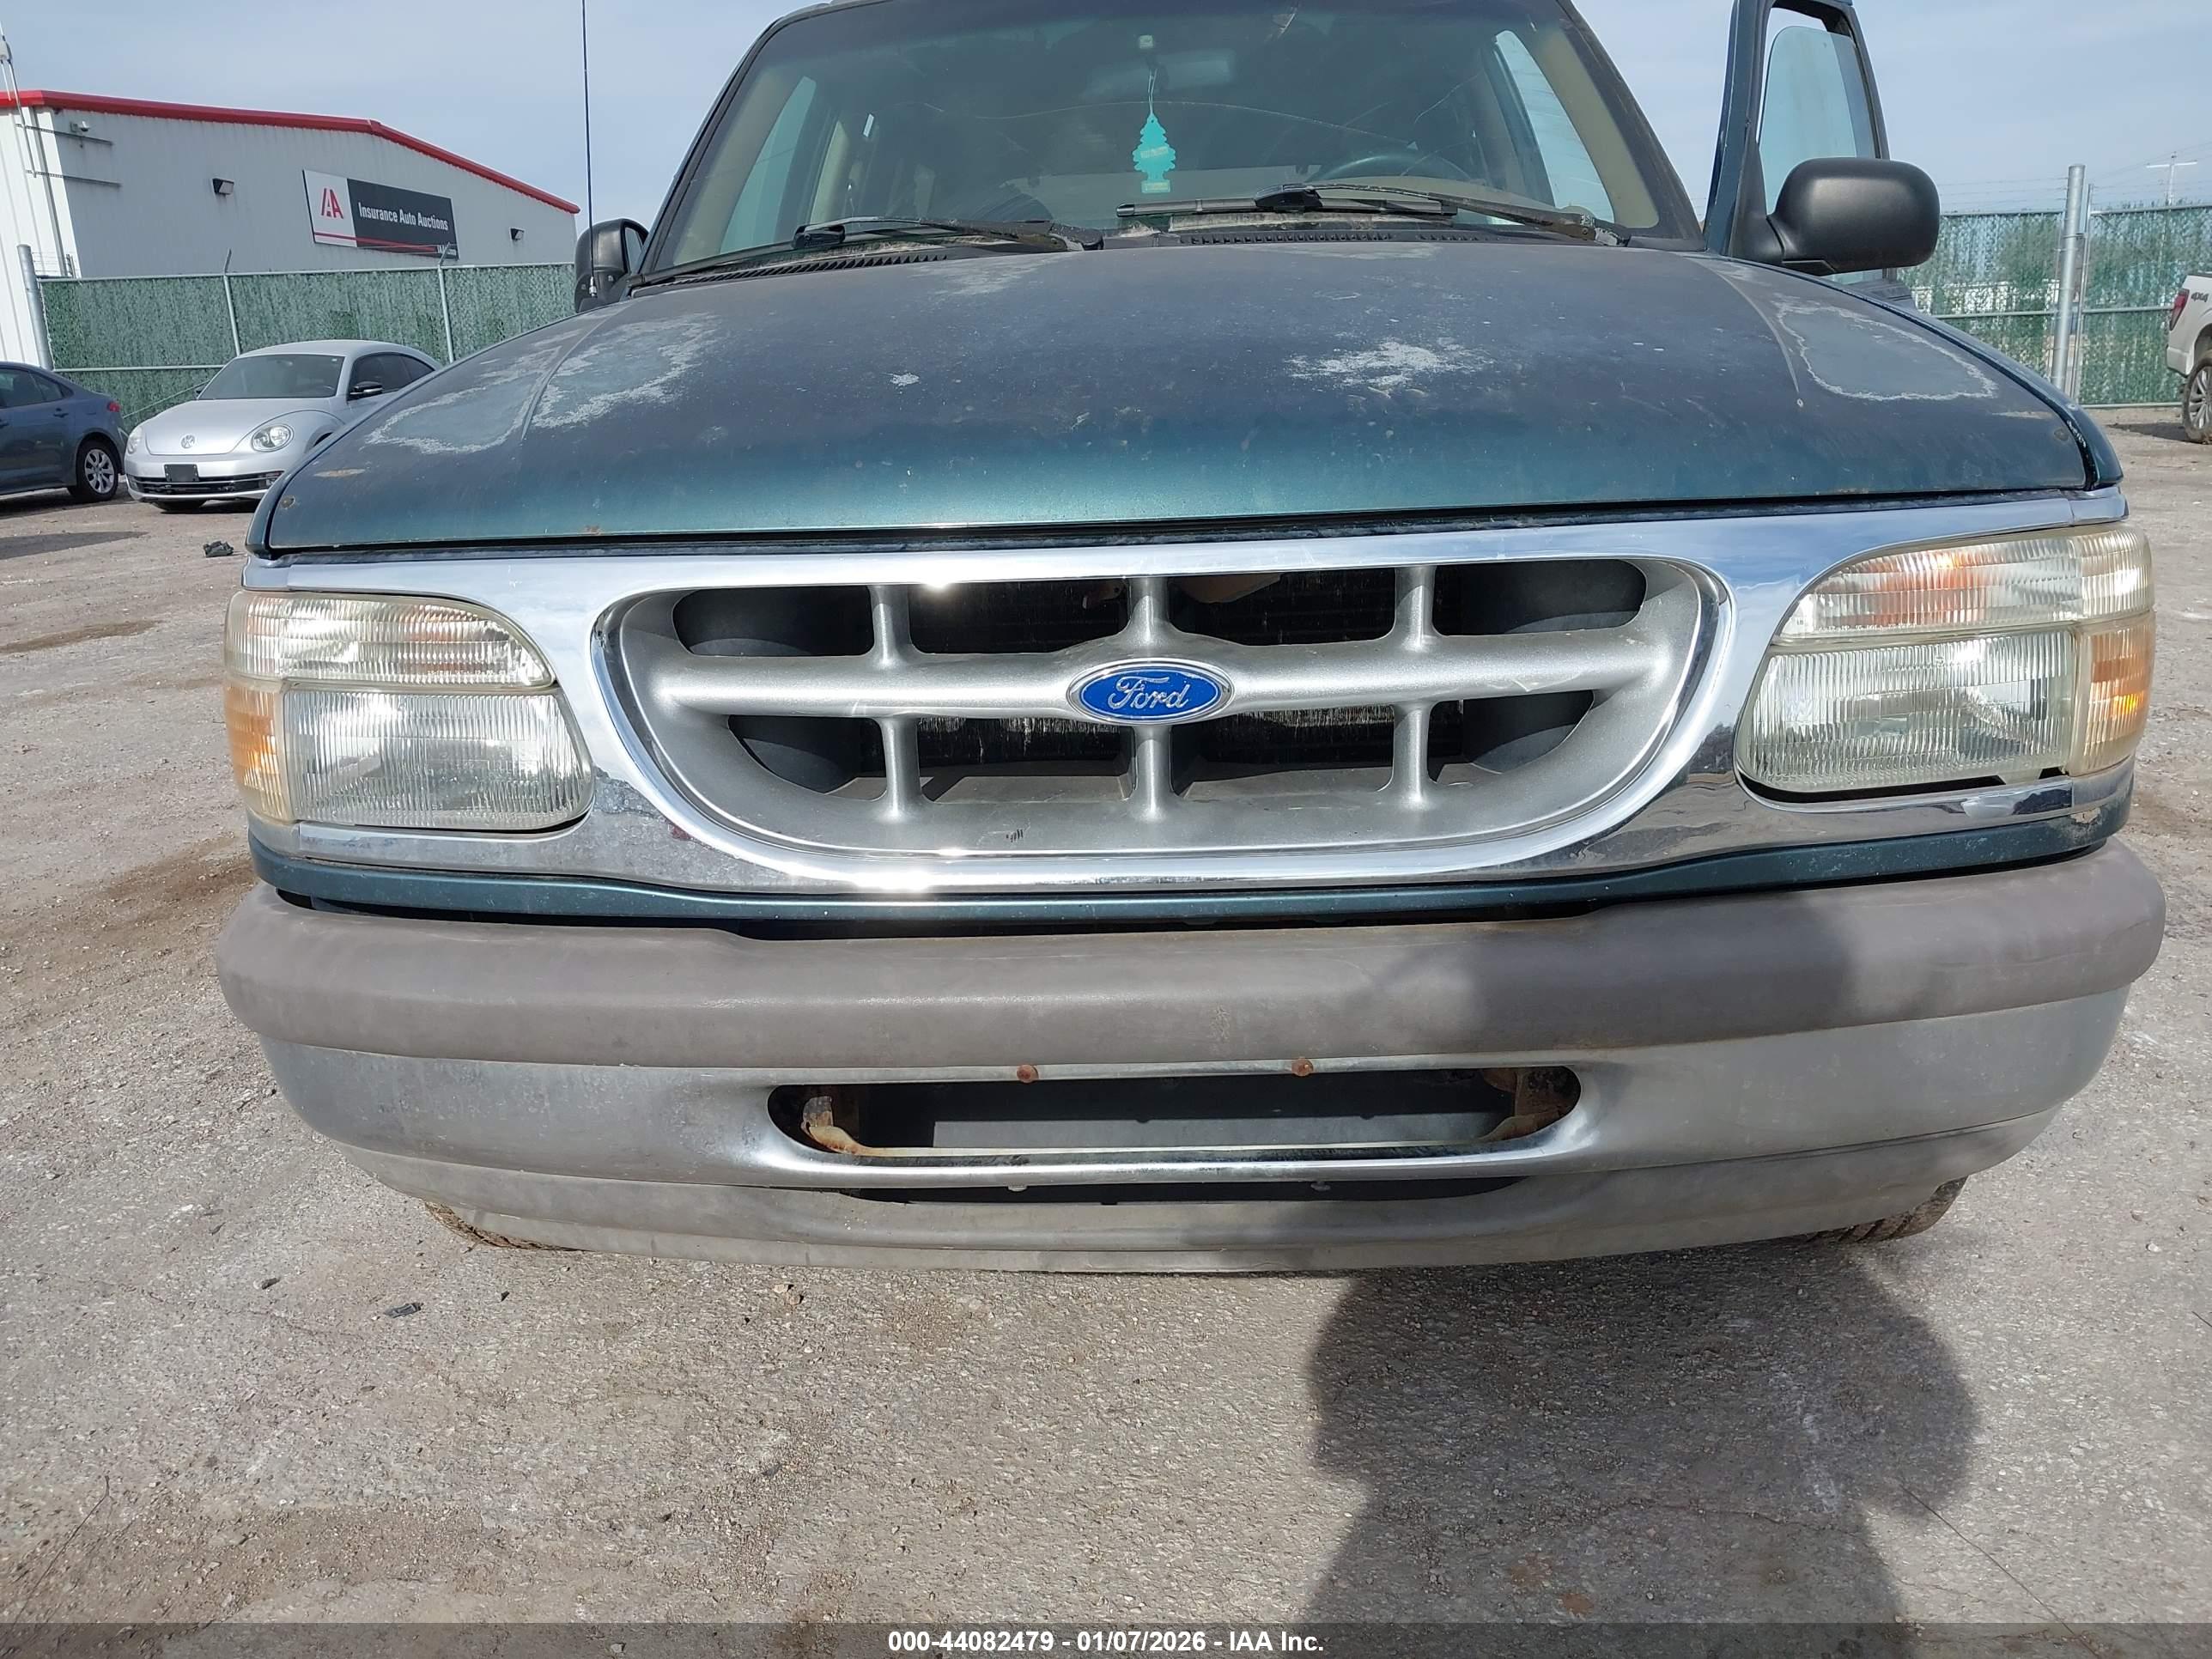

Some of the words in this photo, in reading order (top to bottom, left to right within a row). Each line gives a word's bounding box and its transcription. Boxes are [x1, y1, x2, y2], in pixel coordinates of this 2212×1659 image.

[358, 202, 398, 223] Insurance
[399, 209, 416, 226] Auto
[417, 212, 449, 231] Auctions
[1108, 676, 1192, 709] Ford
